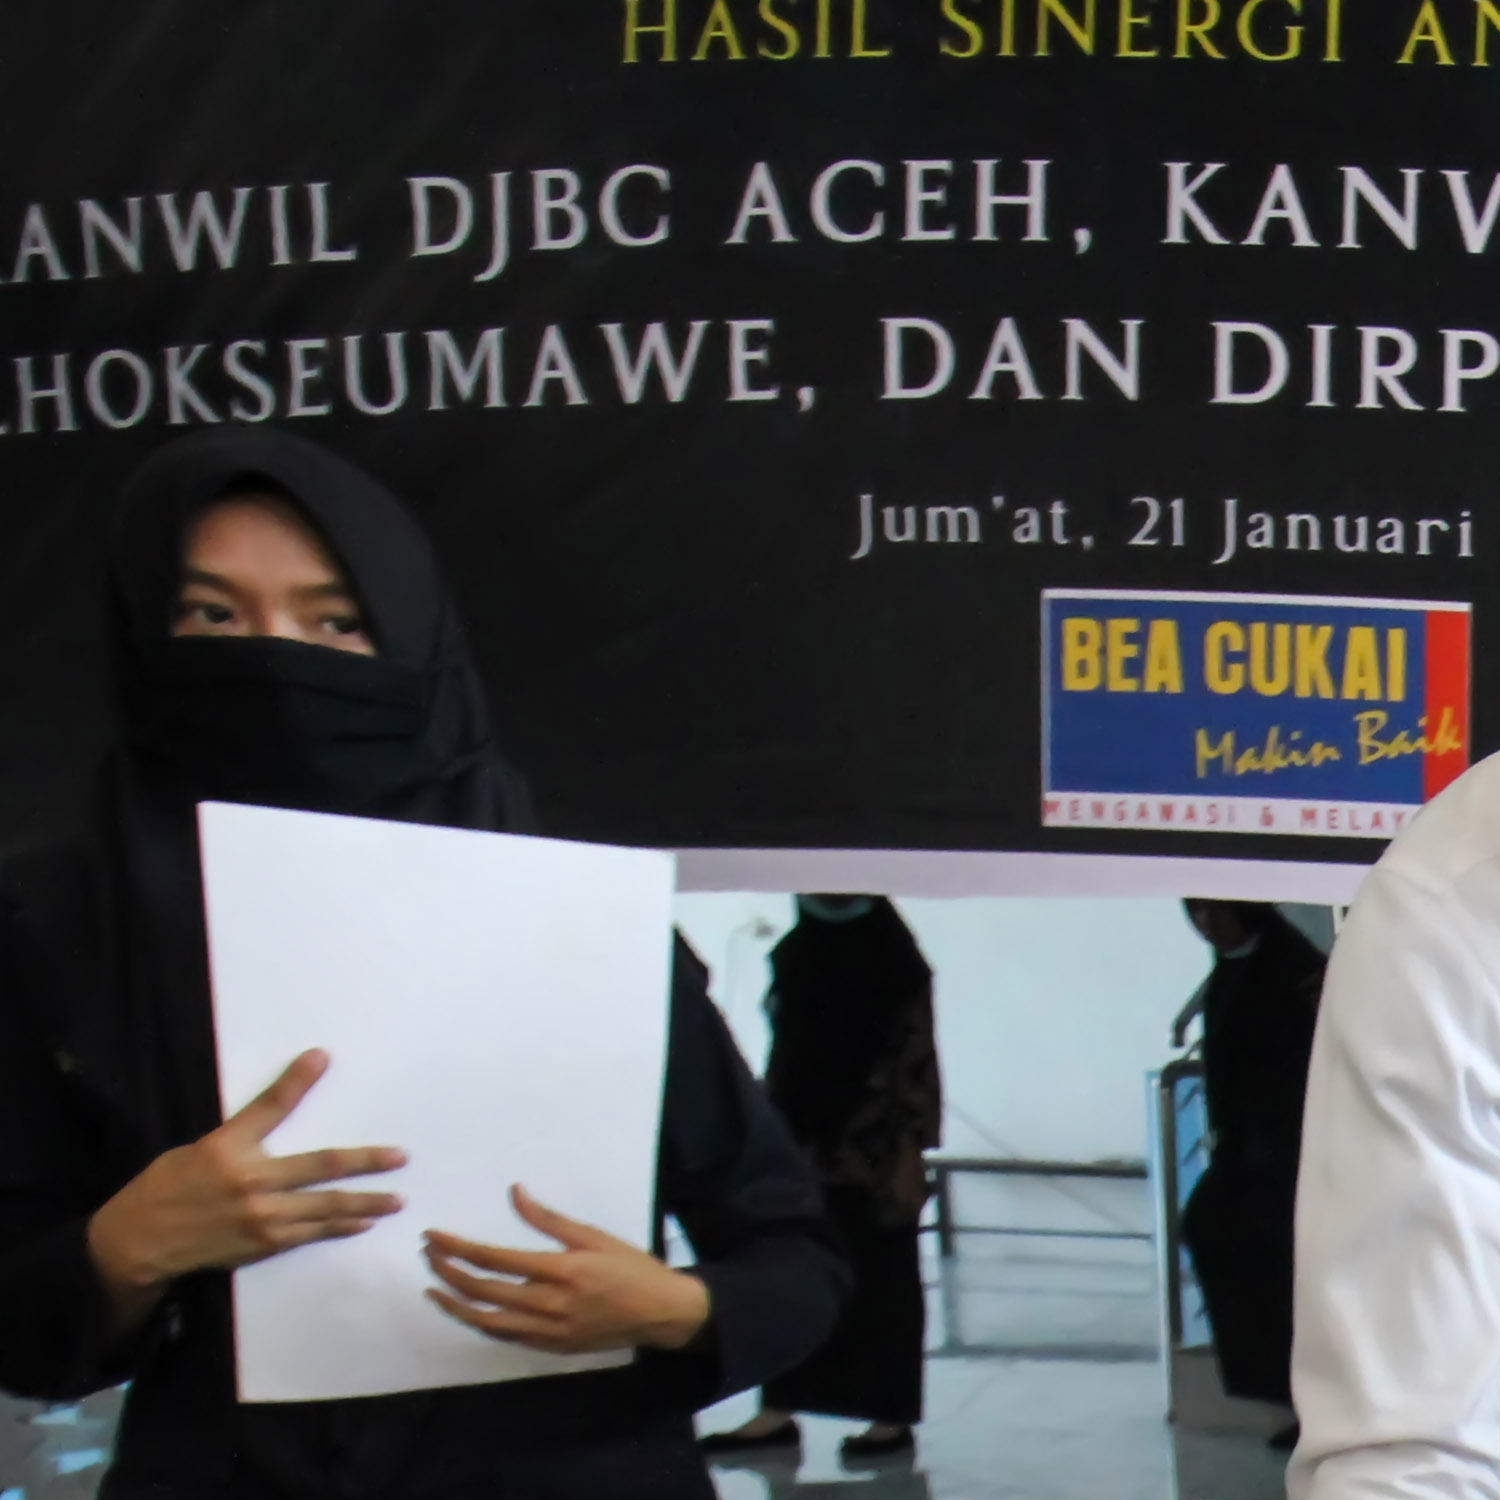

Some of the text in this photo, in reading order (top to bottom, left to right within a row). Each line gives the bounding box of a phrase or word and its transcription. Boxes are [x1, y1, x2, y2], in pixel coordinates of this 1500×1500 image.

[622, 0, 891, 63] HASIL
[939, 0, 1343, 63] SINERGI
[0, 182, 358, 284] ANWIL
[407, 164, 672, 282] DJBC
[724, 159, 1091, 254] ACEH,
[0, 318, 815, 435] HOKSEUMAWE,
[881, 317, 1144, 402] DAN
[1127, 496, 1184, 546] 21
[1211, 498, 1475, 565] Januari
[1061, 617, 1408, 701] BEA CUKAI
[1196, 706, 1463, 779] Makin Baik
